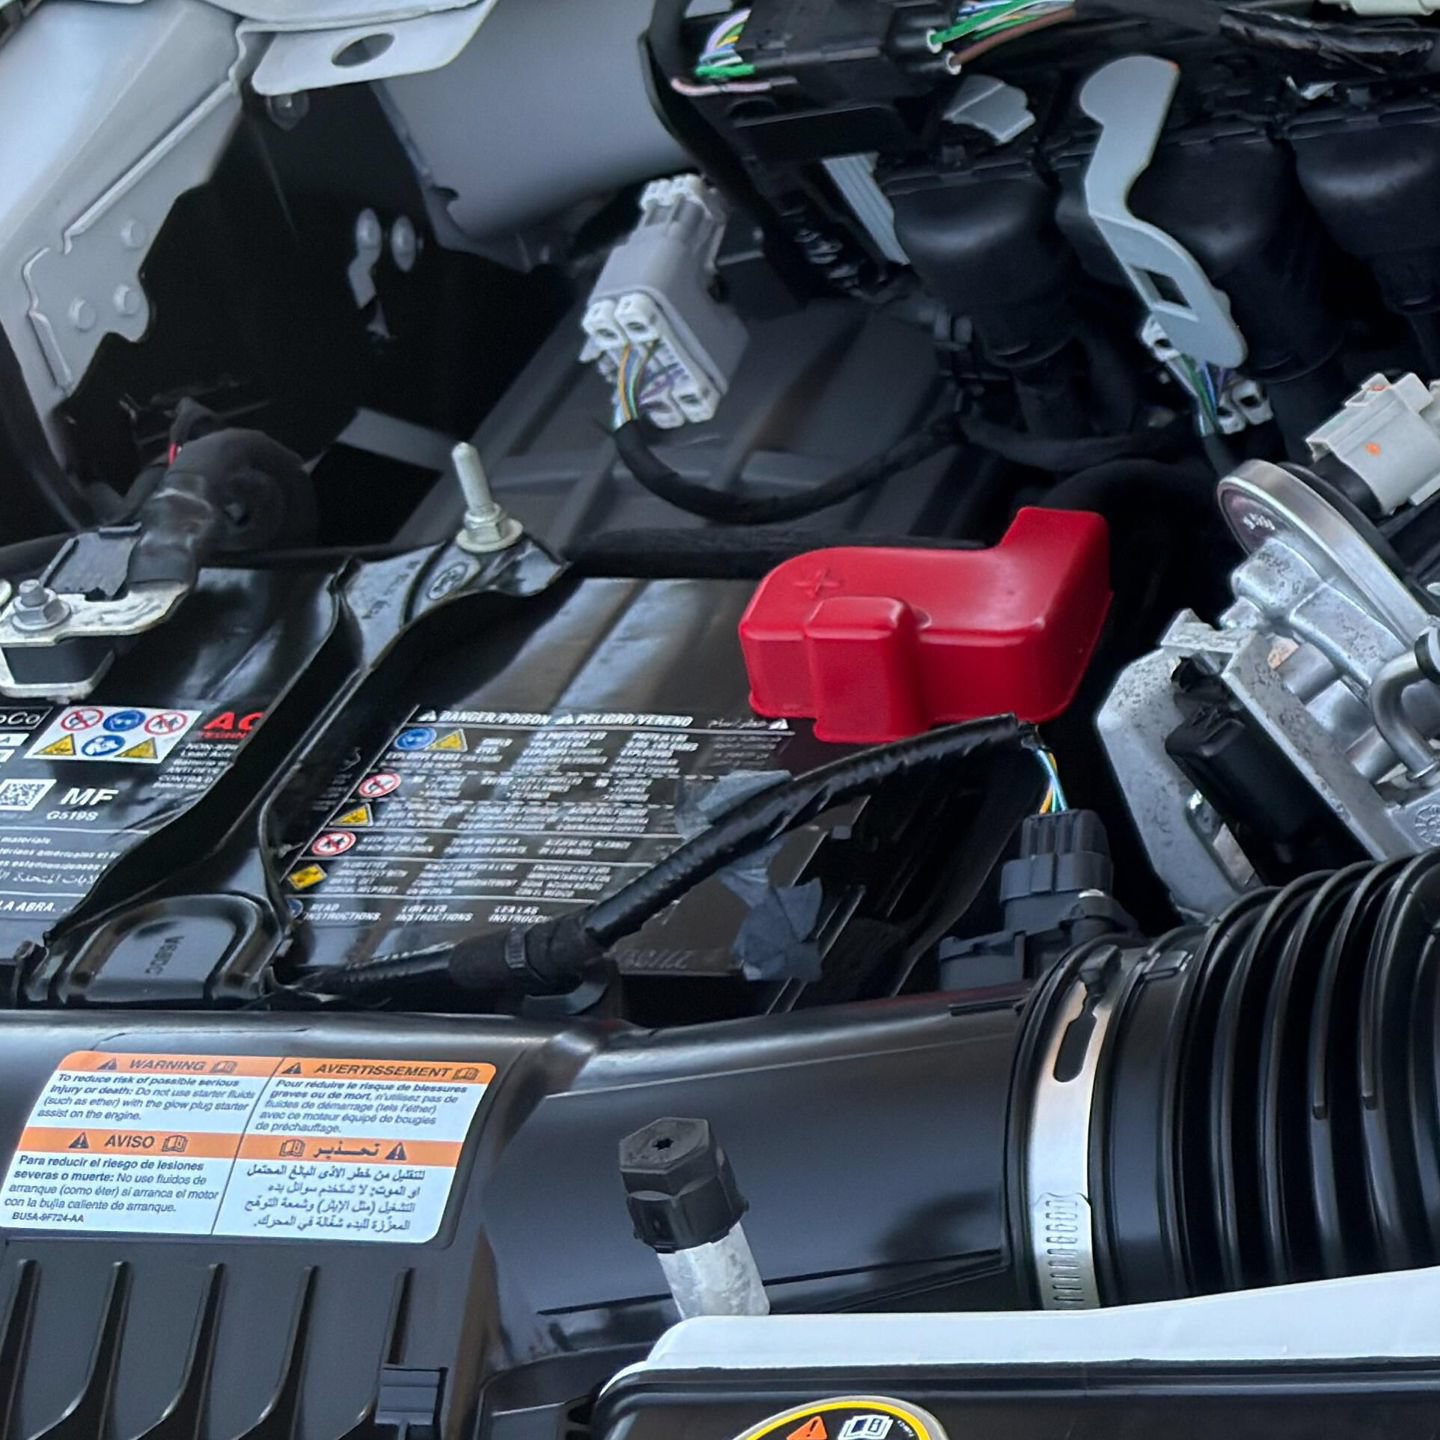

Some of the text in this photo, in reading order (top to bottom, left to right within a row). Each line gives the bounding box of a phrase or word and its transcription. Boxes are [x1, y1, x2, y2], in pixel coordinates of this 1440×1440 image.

[439, 711, 550, 725] DANGER/POISON
[576, 713, 693, 727] PELIGRO/VENENO
[60, 788, 119, 806] MF
[129, 1060, 207, 1071] WARNING
[314, 1064, 452, 1077] AVERTISSEMENT
[58, 1074, 239, 1087] To reduce risk of possible serious
[275, 1079, 303, 1088] Pour
[346, 1081, 358, 1090] le
[359, 1082, 395, 1092] risque
[397, 1083, 412, 1091] de
[413, 1083, 468, 1094] blessures
[98, 1086, 133, 1095] death:
[135, 1087, 150, 1096] Do
[152, 1088, 170, 1097] not
[172, 1089, 190, 1097] use
[192, 1090, 225, 1098] starter
[270, 1090, 308, 1100] graves
[327, 1091, 342, 1099] de
[422, 1095, 441, 1104] pas
[443, 1094, 458, 1103] de
[75, 1098, 87, 1106] as
[122, 1099, 143, 1107] with
[146, 1100, 162, 1108] the
[215, 1102, 249, 1111] starter
[301, 1101, 316, 1109] de
[37, 1109, 68, 1118] assist
[86, 1110, 102, 1119] the
[259, 1112, 285, 1120] avec
[379, 1115, 393, 1123] de
[394, 1115, 437, 1126] bougies
[255, 1122, 269, 1131] de
[104, 1135, 155, 1148] AVISO
[18, 1155, 204, 1171] Para reducir el riesgo de lesiones
[13, 1170, 207, 1185] severas o muerte: No use fluidos de
[9, 1185, 57, 1195] arranque
[59, 1184, 93, 1196] (como
[121, 1187, 132, 1196] si
[134, 1188, 173, 1198] arranca
[176, 1189, 186, 1198] el
[187, 1190, 219, 1200] motor
[4, 1198, 176, 1213] con la caliente de arranque.
